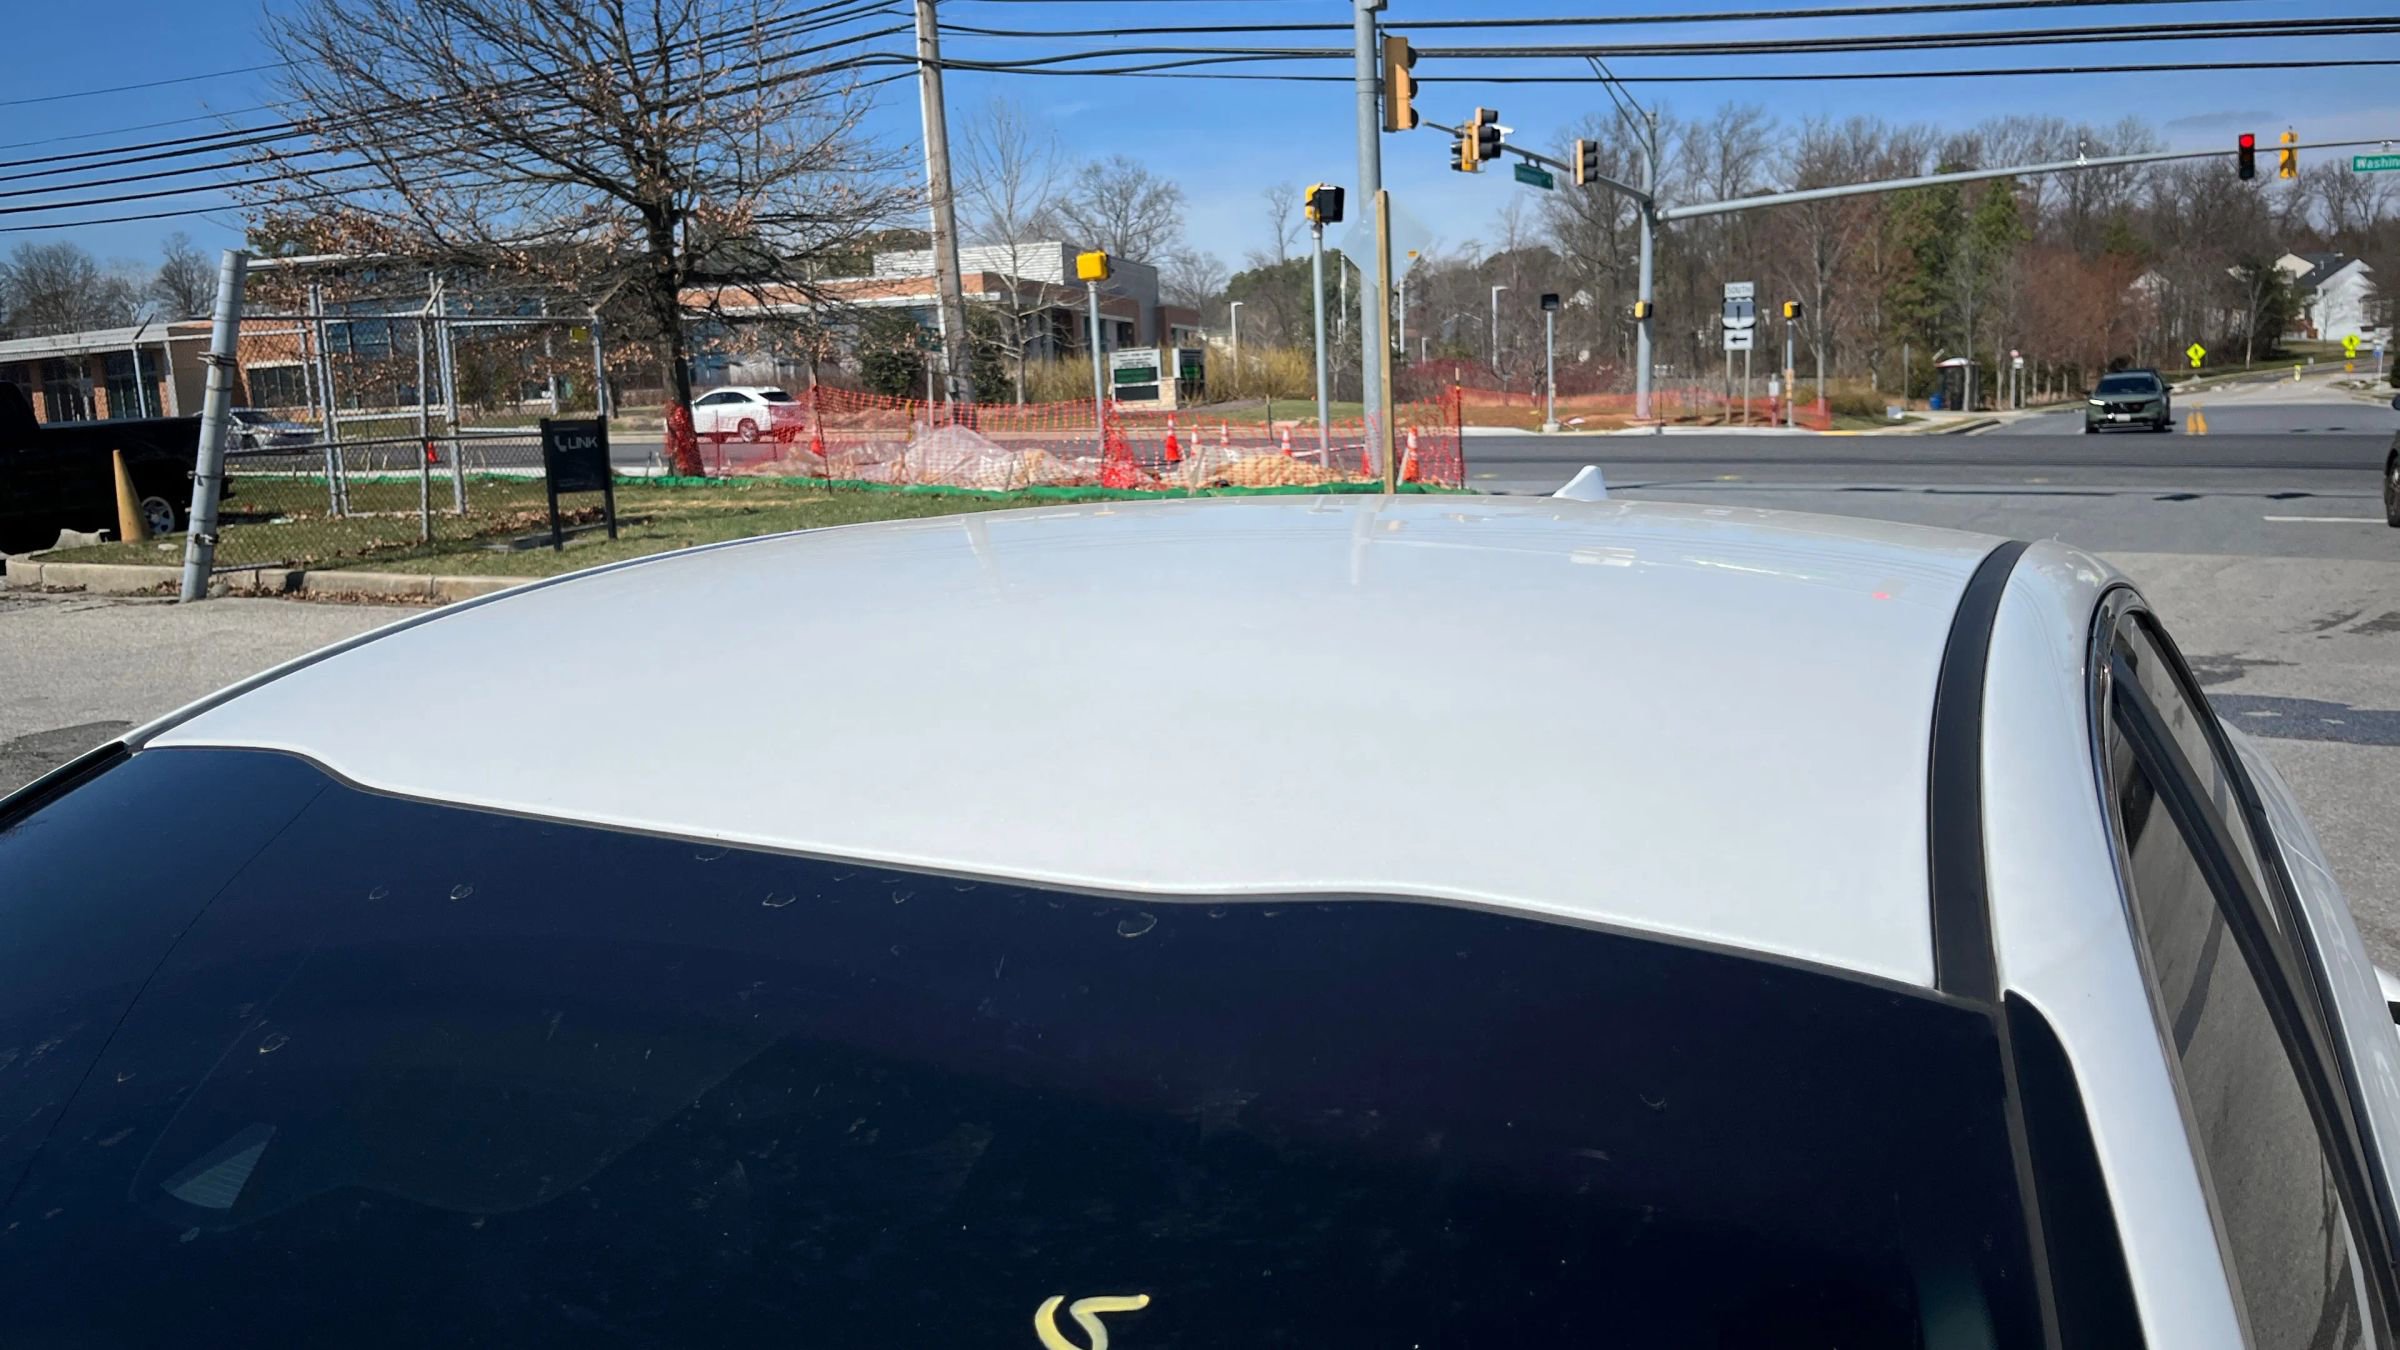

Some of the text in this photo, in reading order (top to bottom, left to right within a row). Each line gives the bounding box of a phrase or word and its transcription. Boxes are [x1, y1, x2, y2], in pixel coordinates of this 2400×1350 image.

[1727, 286, 1752, 294] SOUTH
[1736, 305, 1741, 322] 1
[568, 436, 598, 449] LINK
